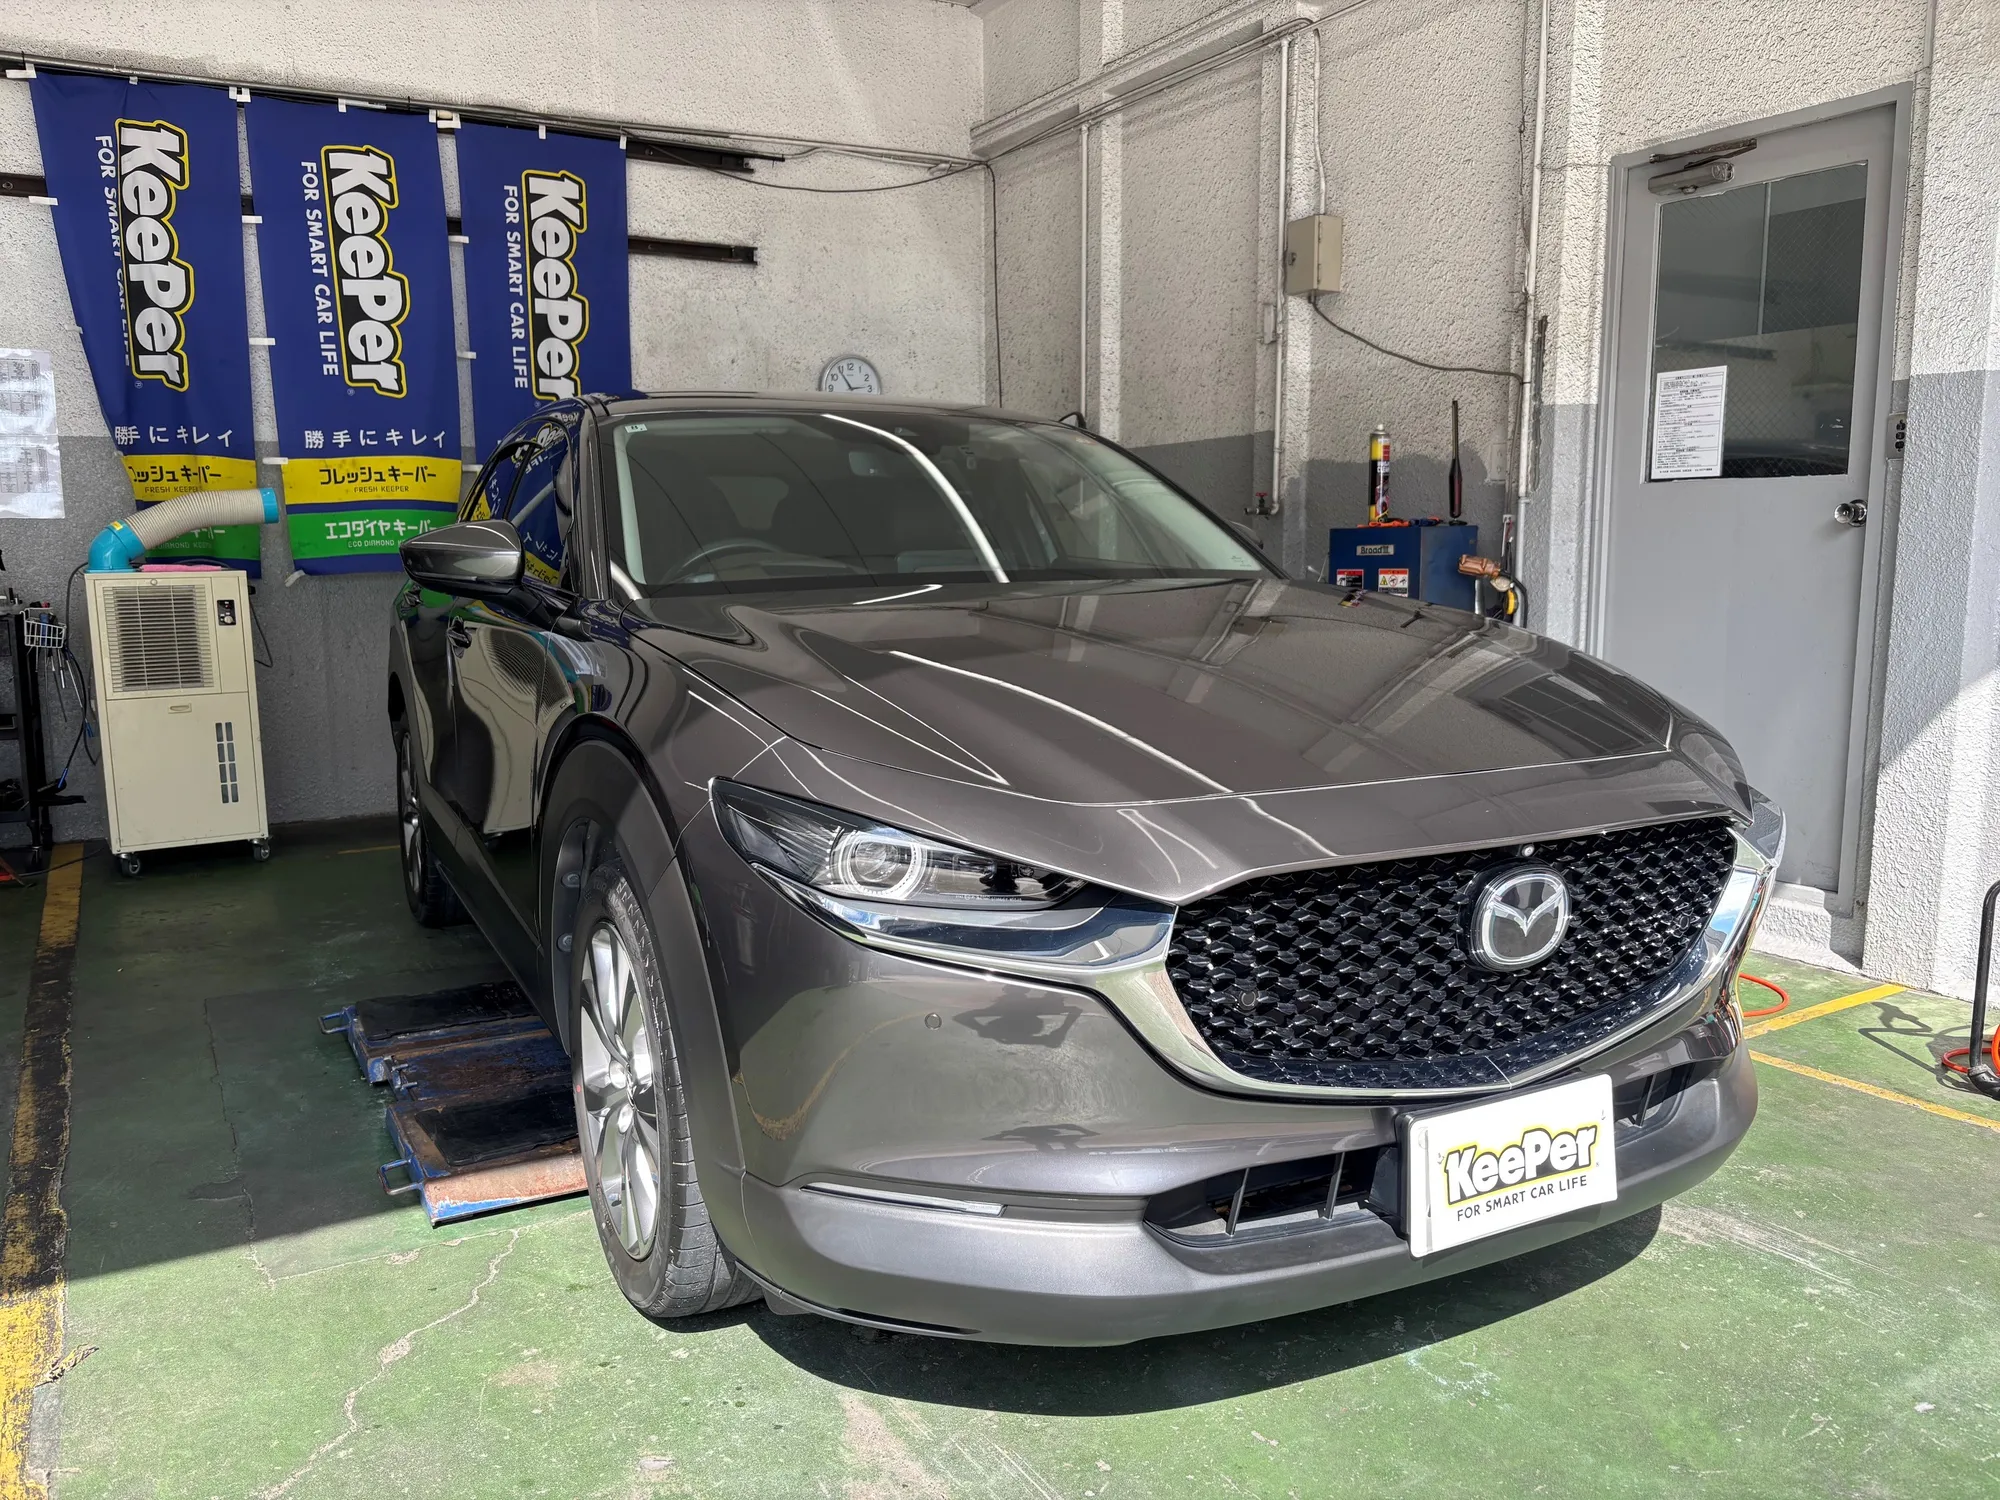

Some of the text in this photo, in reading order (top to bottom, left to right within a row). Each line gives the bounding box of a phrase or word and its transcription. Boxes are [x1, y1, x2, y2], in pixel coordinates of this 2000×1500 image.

[95, 135, 116, 179] FOR
[104, 186, 123, 261] SMART
[119, 126, 189, 386] KeePer
[301, 161, 339, 376] FOR SMART CAR LIFE
[327, 151, 404, 392] KeePer
[503, 185, 528, 388] FOR SMART CAR LIFE
[847, 362, 855, 371] 12
[864, 373, 870, 382] 2
[304, 428, 446, 449] 勝手にキレイ
[145, 486, 171, 494] FRESH
[319, 465, 437, 485] フレッシュキーパー
[381, 485, 409, 493] KEEPER
[348, 540, 362, 548] ECO
[364, 539, 395, 547] DIAMOND
[1445, 1124, 1598, 1206] KeePer
[1456, 1175, 1588, 1222] FOR SMART CAR LIFE
